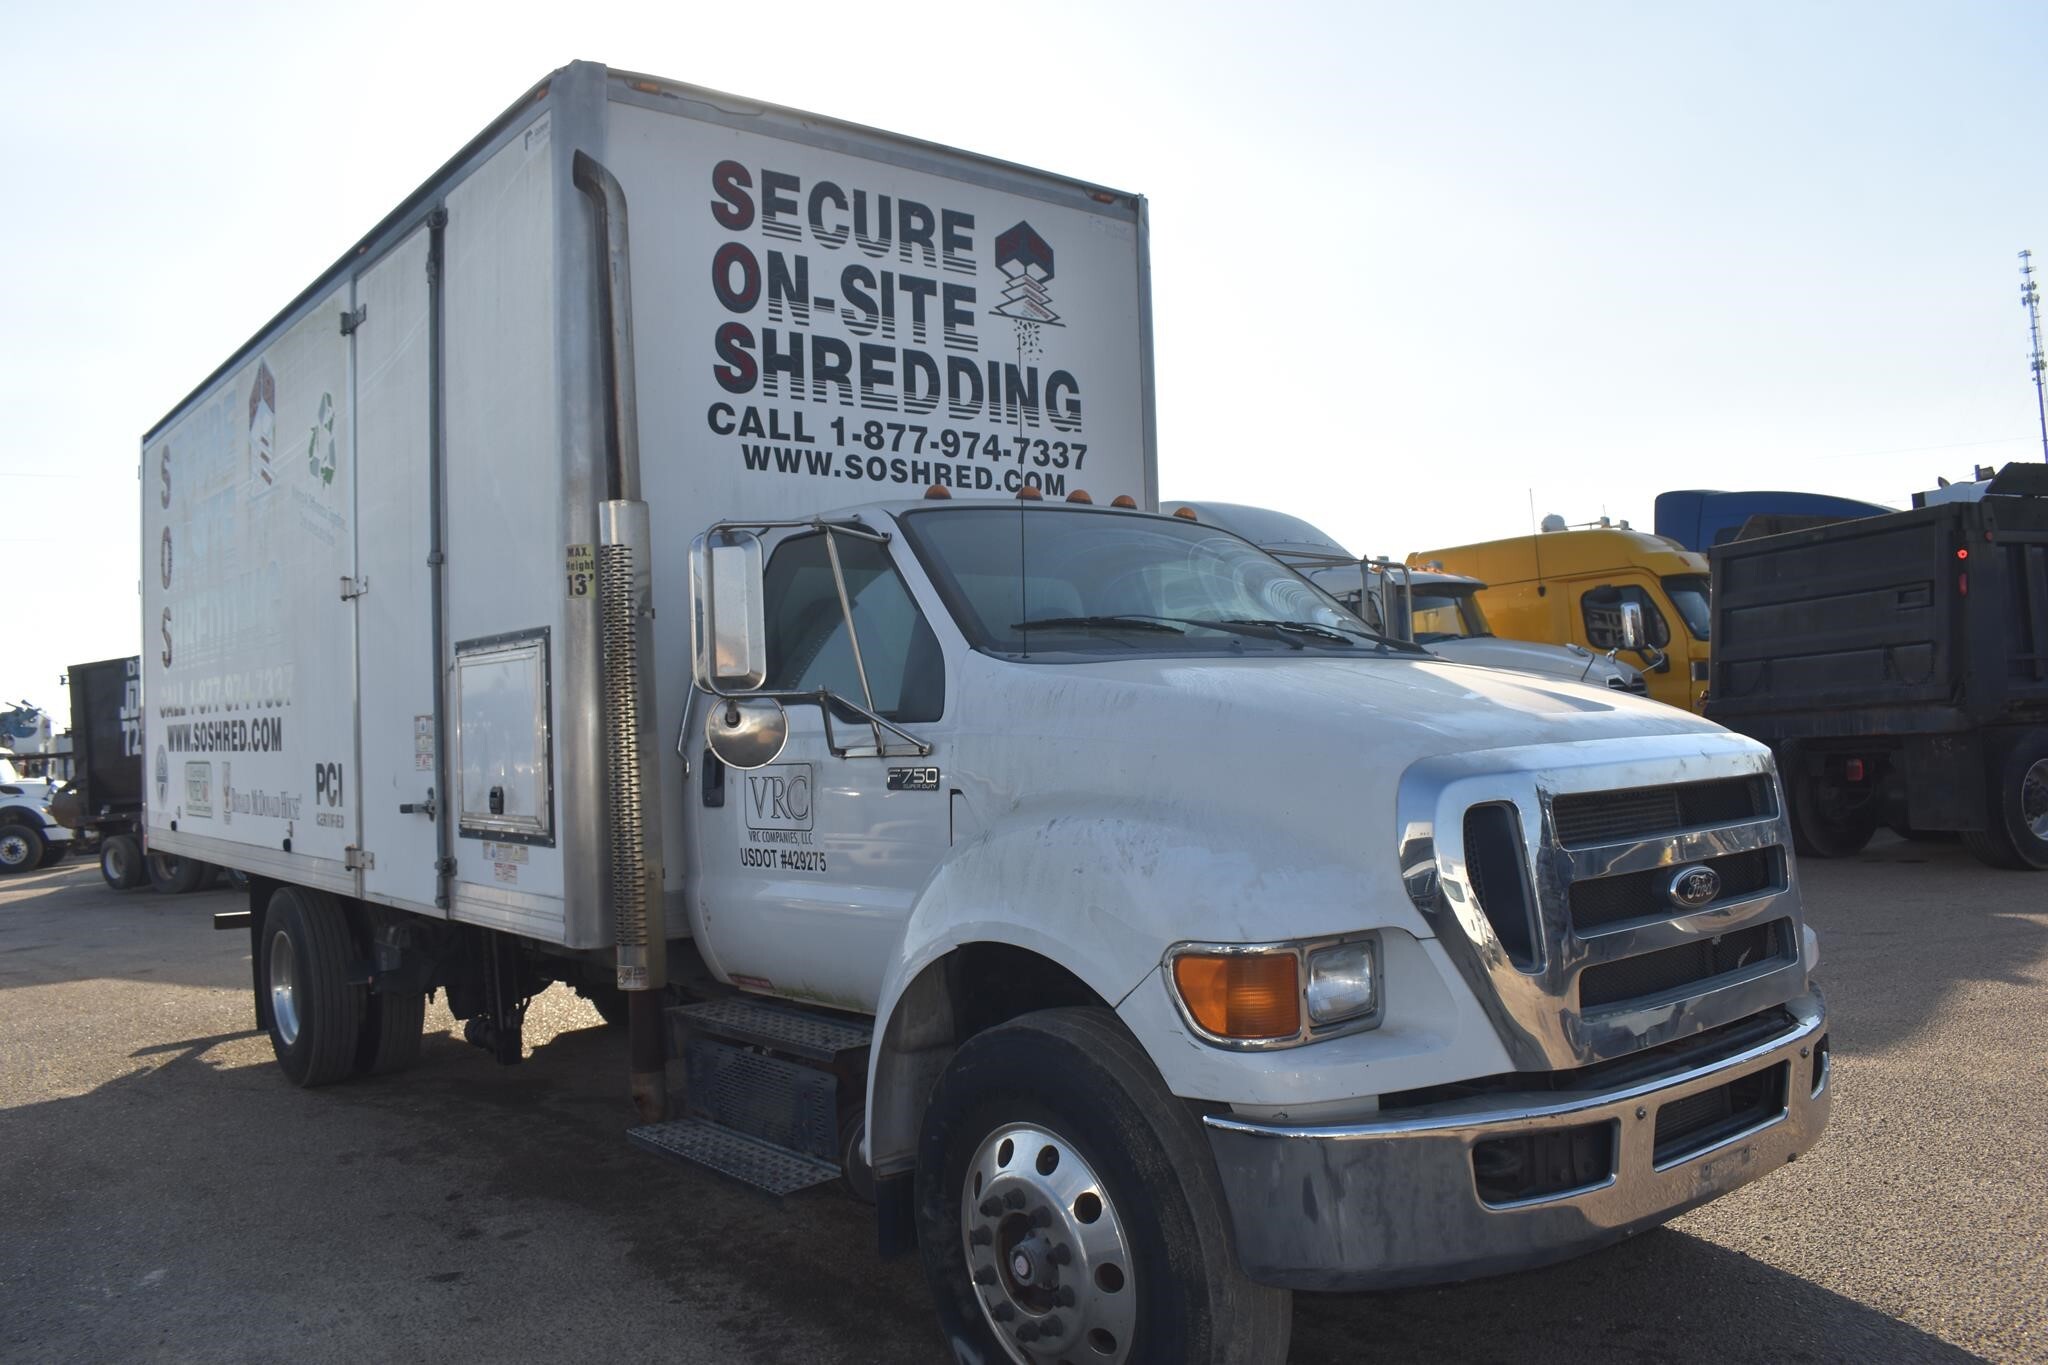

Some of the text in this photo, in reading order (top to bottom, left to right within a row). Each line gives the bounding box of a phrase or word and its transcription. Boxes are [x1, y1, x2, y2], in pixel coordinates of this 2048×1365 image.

[711, 160, 977, 276] SECURE
[712, 241, 979, 352] ON-SITE
[713, 321, 1083, 433] SHREDDING
[707, 402, 1088, 470] CALL 1-877-974-7337
[741, 444, 1067, 496] WWW.SOSHRED.COM
[567, 546, 592, 557] MAX.
[167, 717, 283, 752] WWW.SOSHRED.COM
[315, 762, 343, 808] PCI
[748, 775, 809, 821] VRC
[740, 847, 827, 872] USDOT #429275
[748, 830, 814, 846] VRC COMPANIES, LLC
[1687, 873, 1714, 899] Ford
